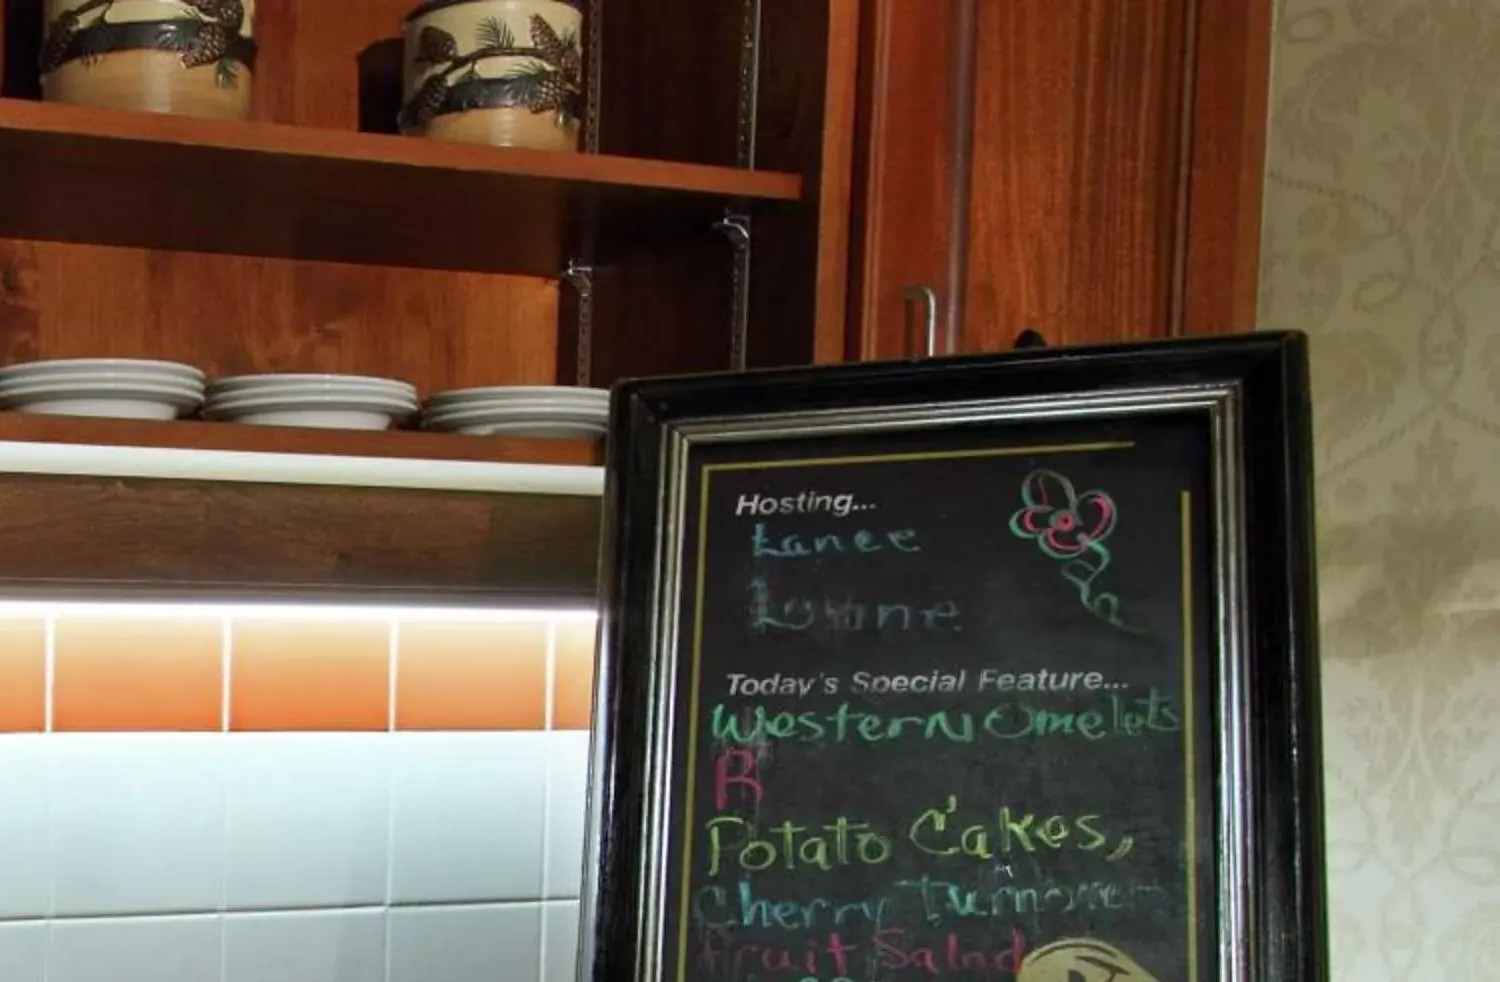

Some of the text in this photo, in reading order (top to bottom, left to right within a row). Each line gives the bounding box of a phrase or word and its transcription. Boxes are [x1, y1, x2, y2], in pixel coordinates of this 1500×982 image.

[736, 490, 877, 517] Hosting...
[726, 667, 1129, 699] Today's Special Feature...
[705, 815, 892, 876] Potato
